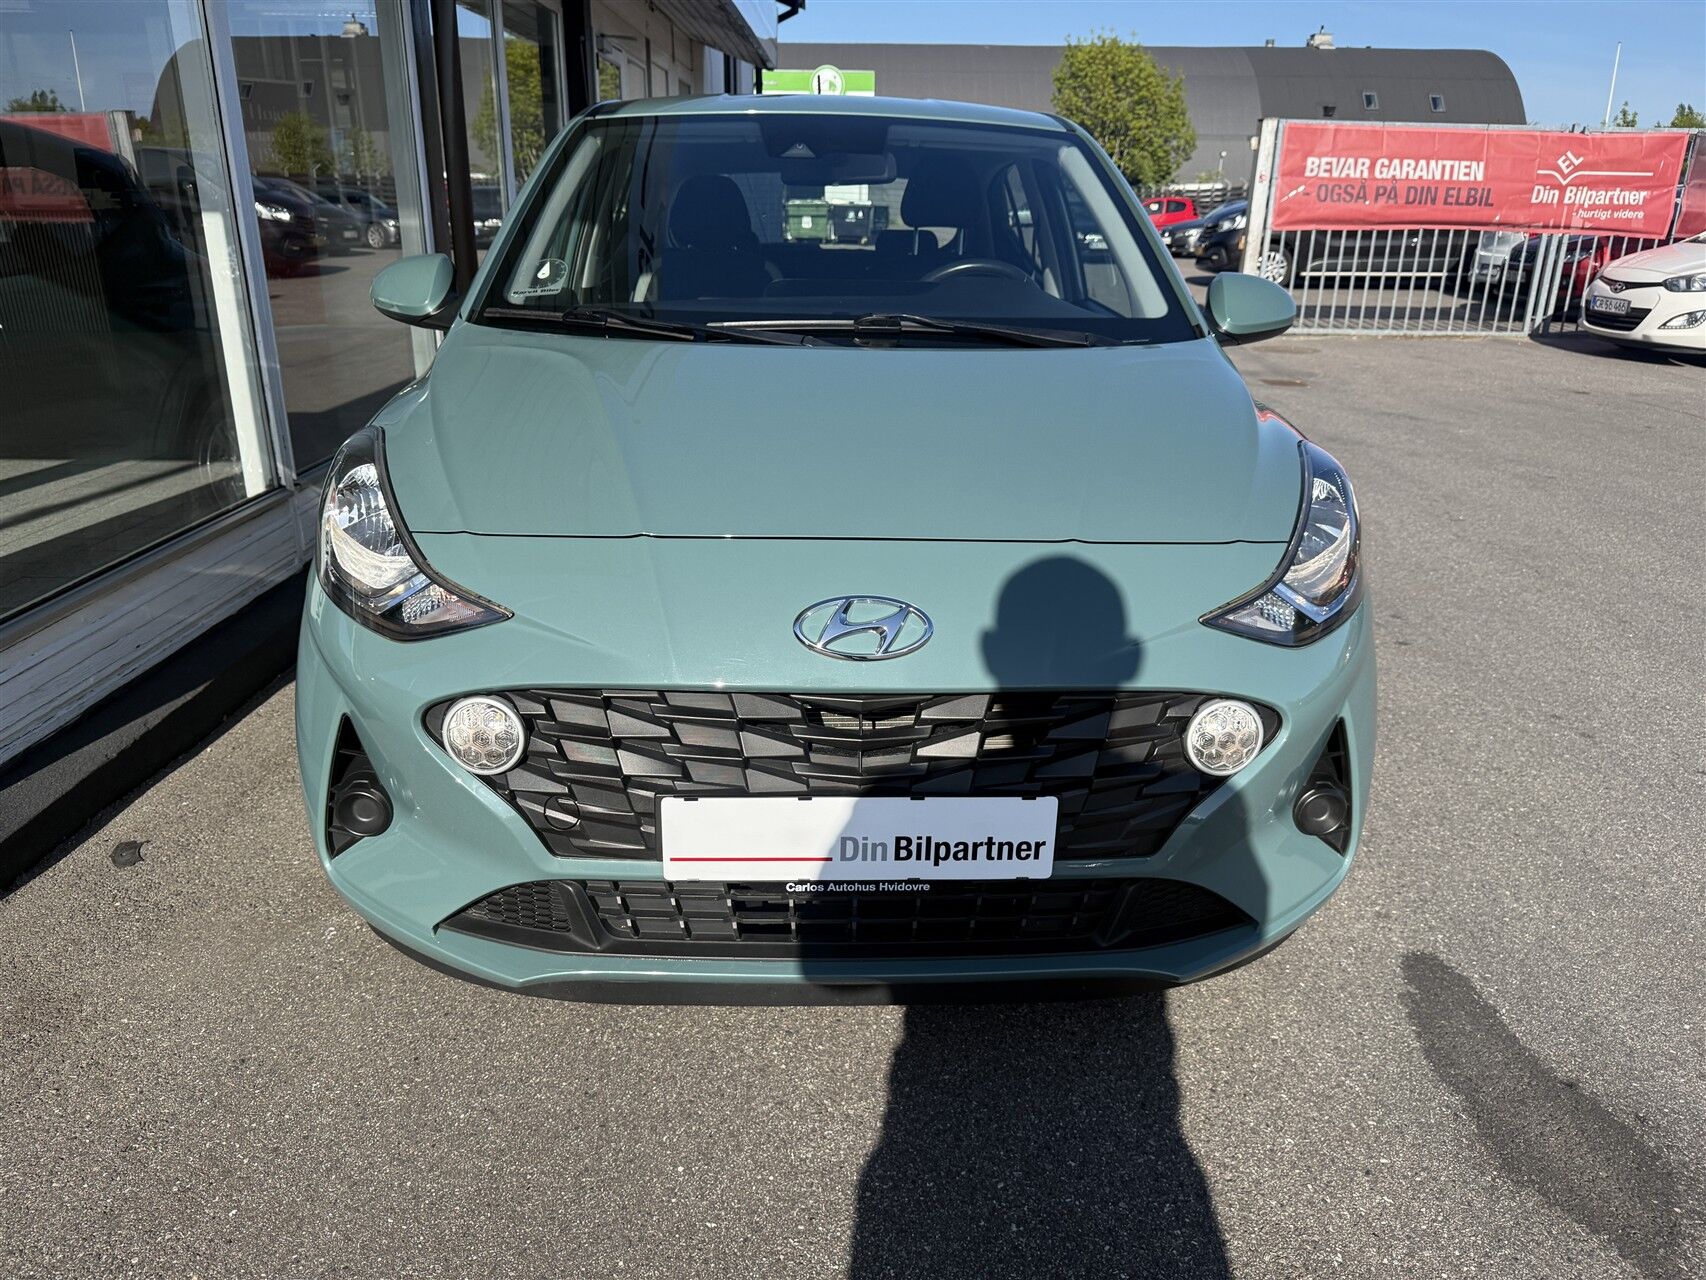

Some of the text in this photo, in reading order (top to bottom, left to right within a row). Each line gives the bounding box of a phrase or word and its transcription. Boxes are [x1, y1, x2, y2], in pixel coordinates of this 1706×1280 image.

[1304, 157, 1485, 181] BEVAR GARANTIEN
[1557, 150, 1585, 175] EL
[1316, 179, 1367, 203] OGSÅ
[1374, 179, 1399, 204] PÅ
[1405, 185, 1438, 206] DIN
[1442, 187, 1495, 207] ELBIL
[1531, 185, 1648, 208] Din Bilpartner
[1578, 208, 1611, 220] hurtigt
[1614, 209, 1645, 218] videre
[839, 836, 1047, 867] Din Bilpartner
[785, 882, 931, 893] Carlos Autohus Hvidovre
